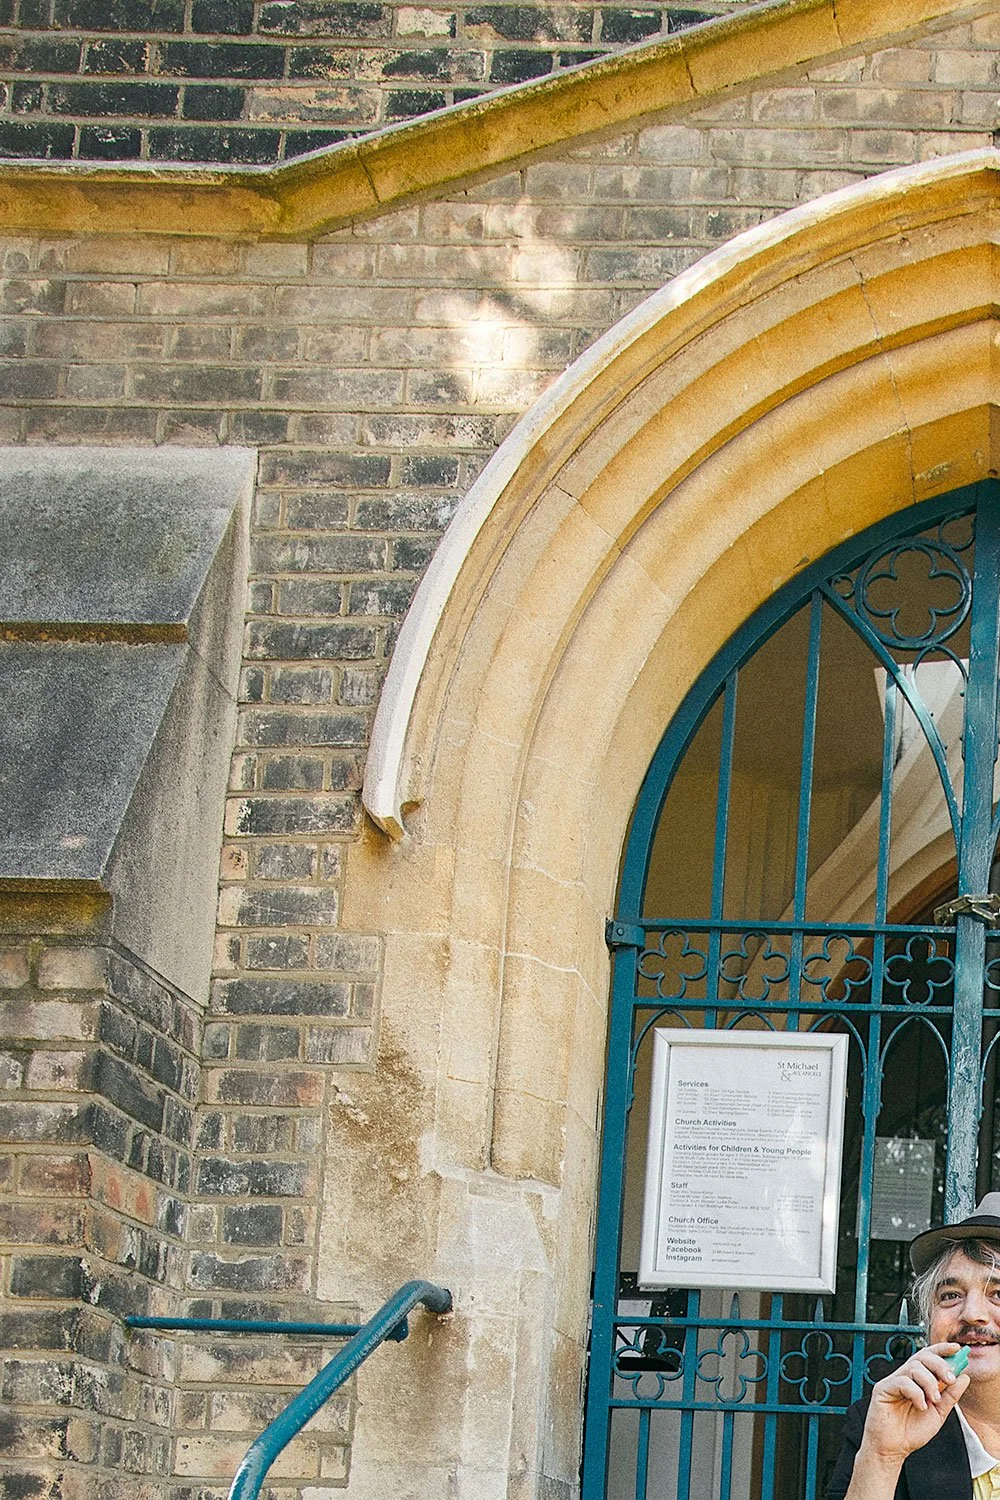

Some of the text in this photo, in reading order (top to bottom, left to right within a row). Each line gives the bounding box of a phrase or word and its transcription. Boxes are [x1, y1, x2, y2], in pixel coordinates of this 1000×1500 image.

[787, 1062, 819, 1070] Michael
[675, 1118, 737, 1127] Church Activities
[673, 1143, 707, 1151] Activities
[721, 1145, 752, 1153] Children
[761, 1146, 785, 1155] Young
[787, 1147, 812, 1156] People
[670, 1181, 688, 1189] Staff
[668, 1216, 719, 1225] Church Office
[667, 1237, 697, 1245] Website
[666, 1254, 702, 1262] Instagram
